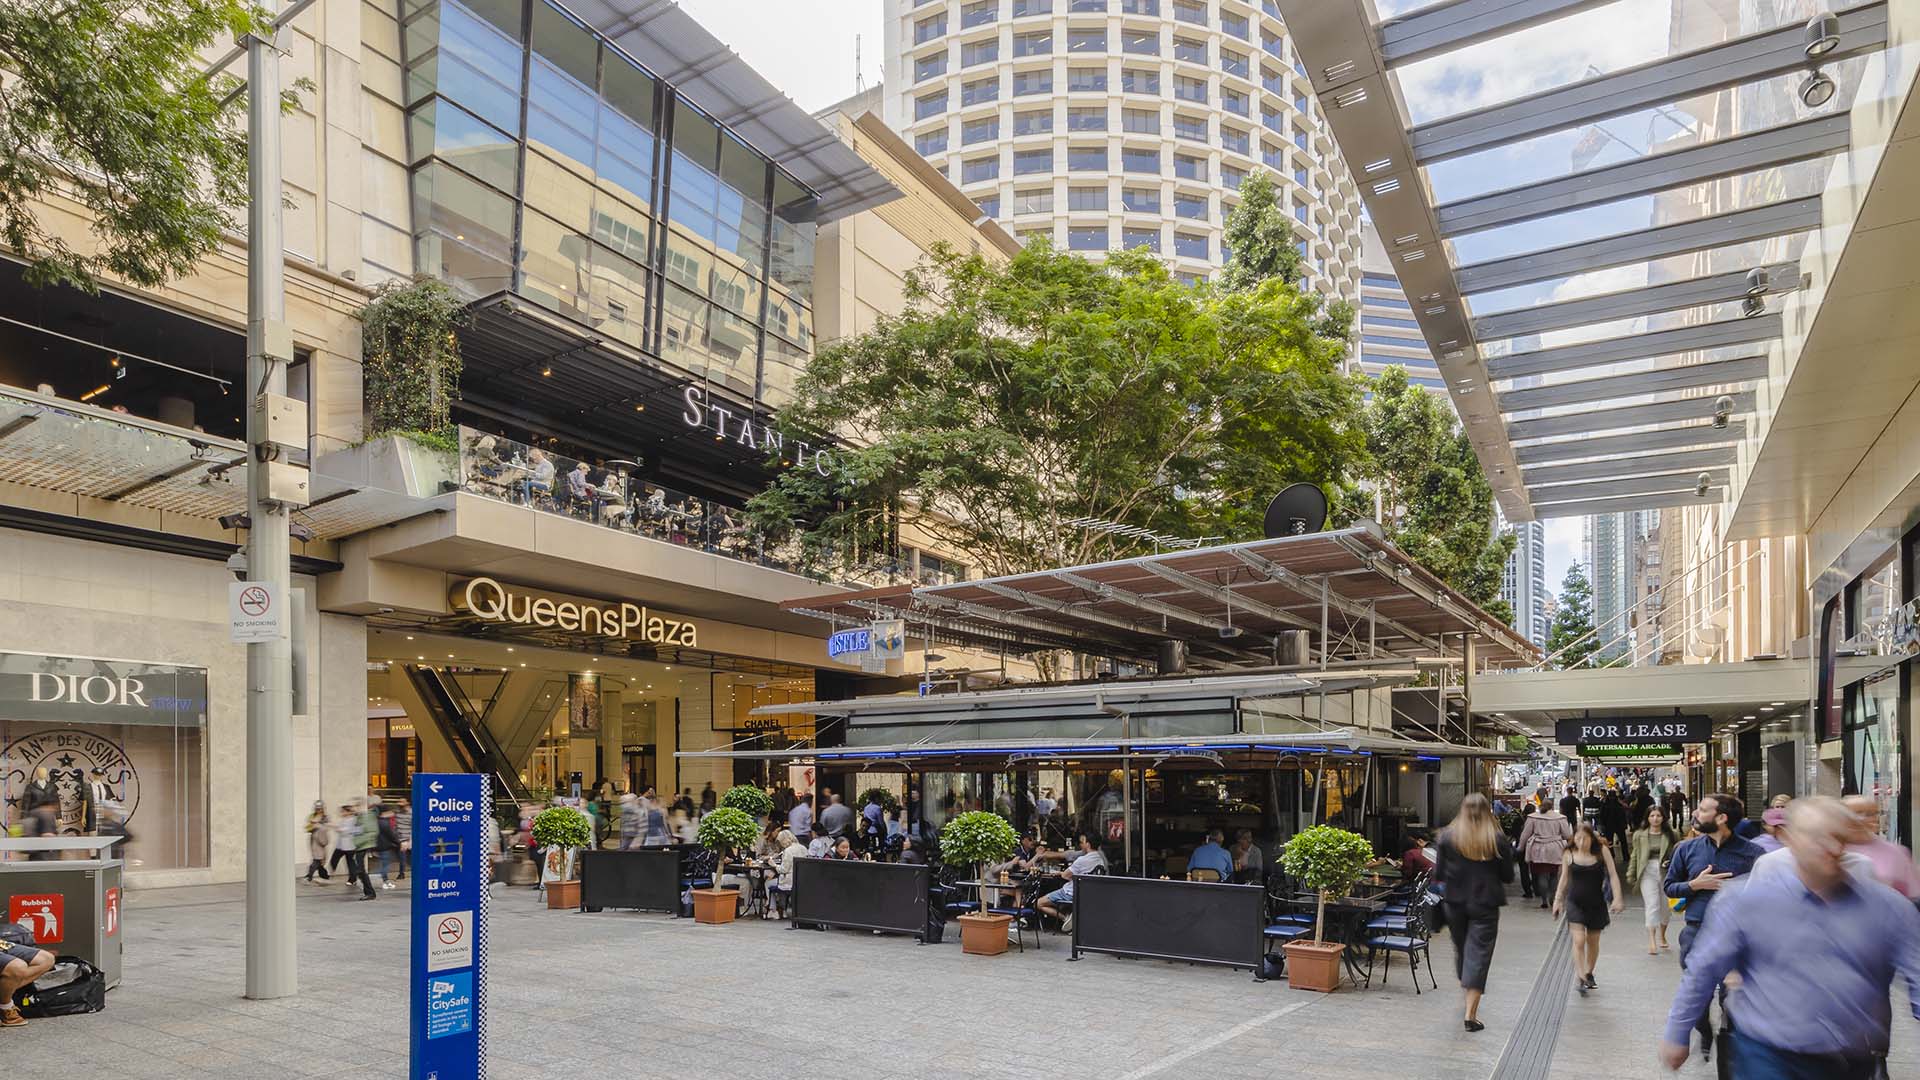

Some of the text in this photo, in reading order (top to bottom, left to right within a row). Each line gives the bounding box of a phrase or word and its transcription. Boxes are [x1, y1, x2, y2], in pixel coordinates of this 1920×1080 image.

[683, 387, 850, 482] STANTO
[465, 577, 697, 648] QueensPlaza
[27, 672, 149, 708] DIOR
[744, 719, 781, 729] CHANEL
[1582, 724, 1688, 738] FOR LEASE
[57, 735, 81, 747] DES
[429, 798, 474, 812] Police
[429, 814, 471, 823] Adelaide St
[441, 880, 456, 889] 000
[21, 898, 52, 906] Rubbish
[442, 946, 469, 954] SMOKING
[432, 995, 470, 1011] CitySafe
